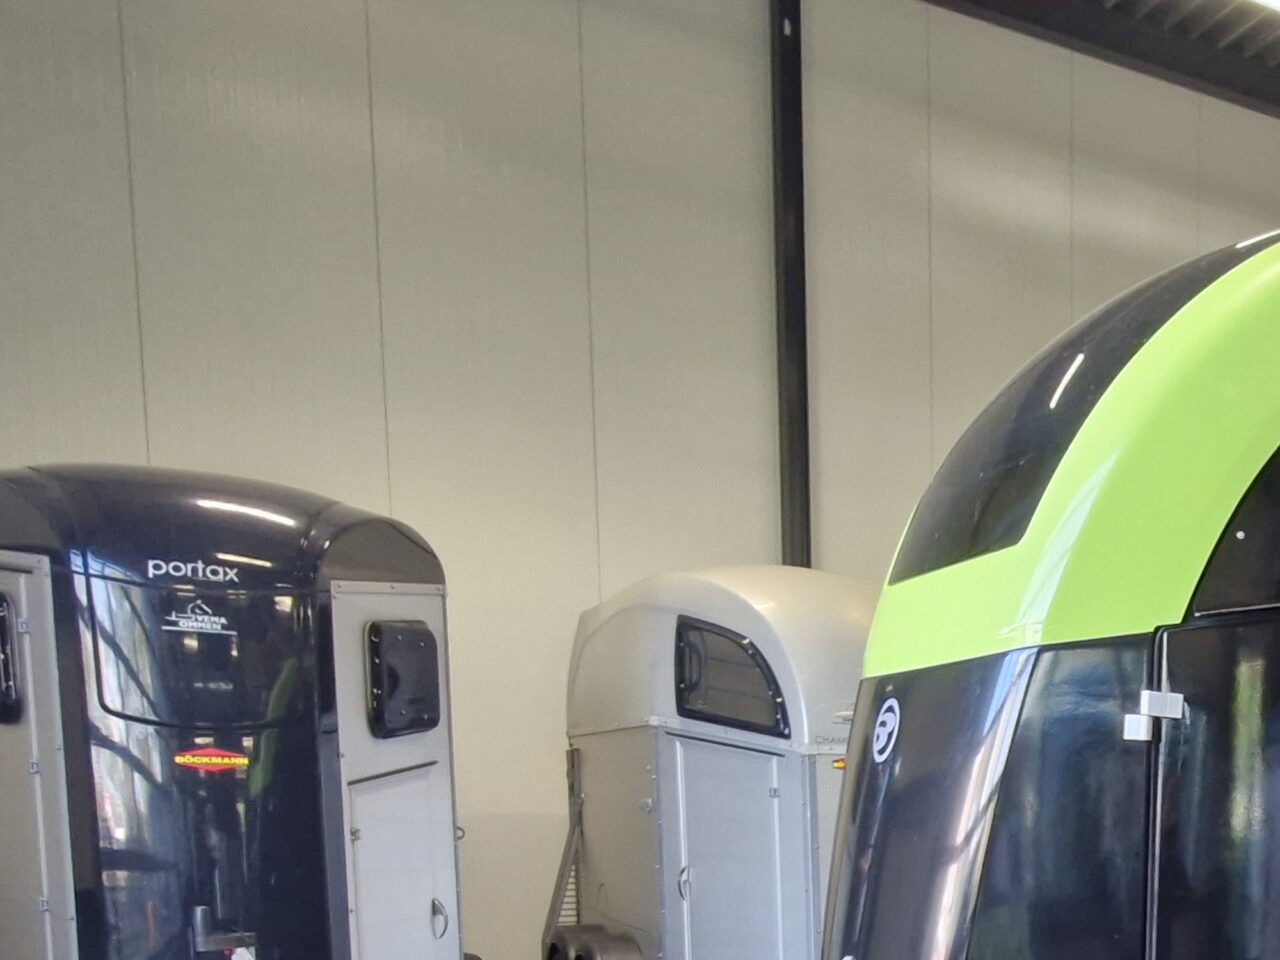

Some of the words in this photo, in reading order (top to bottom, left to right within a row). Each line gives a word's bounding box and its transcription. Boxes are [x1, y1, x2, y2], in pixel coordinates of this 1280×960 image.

[147, 559, 239, 582] portax
[178, 620, 222, 630] OMMEN
[195, 614, 228, 625] VEMA
